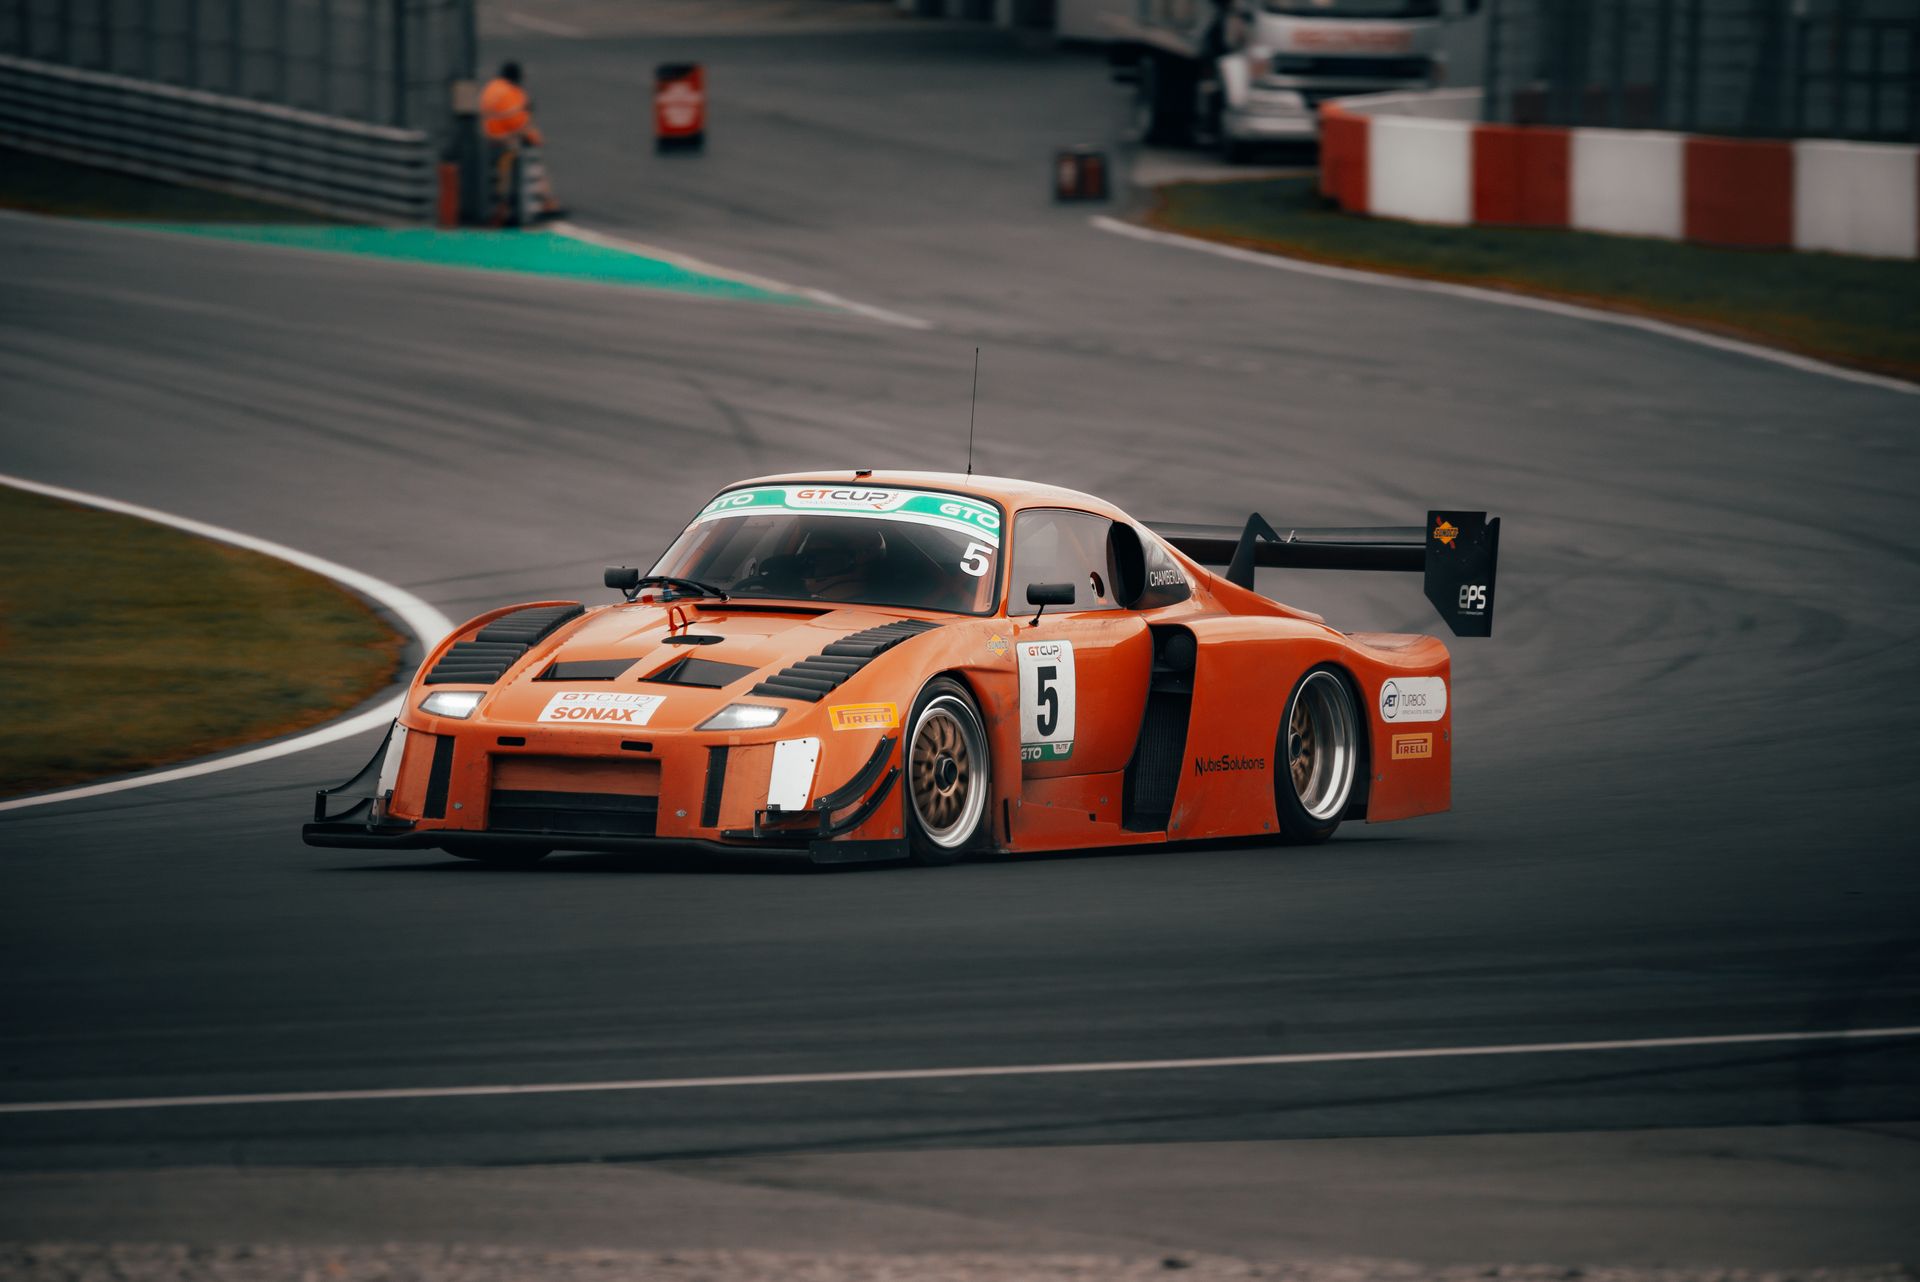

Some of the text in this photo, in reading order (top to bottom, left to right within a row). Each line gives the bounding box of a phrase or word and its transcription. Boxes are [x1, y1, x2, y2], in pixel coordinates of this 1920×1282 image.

[940, 503, 1000, 529] GTO
[959, 541, 993, 577] 5
[1036, 665, 1059, 737] 5
[1401, 693, 1427, 707] TURBOS
[550, 706, 638, 722] SONAX
[836, 707, 894, 725] PIRELLI
[1021, 747, 1042, 760] GTO
[1395, 738, 1429, 755] PIRELLI
